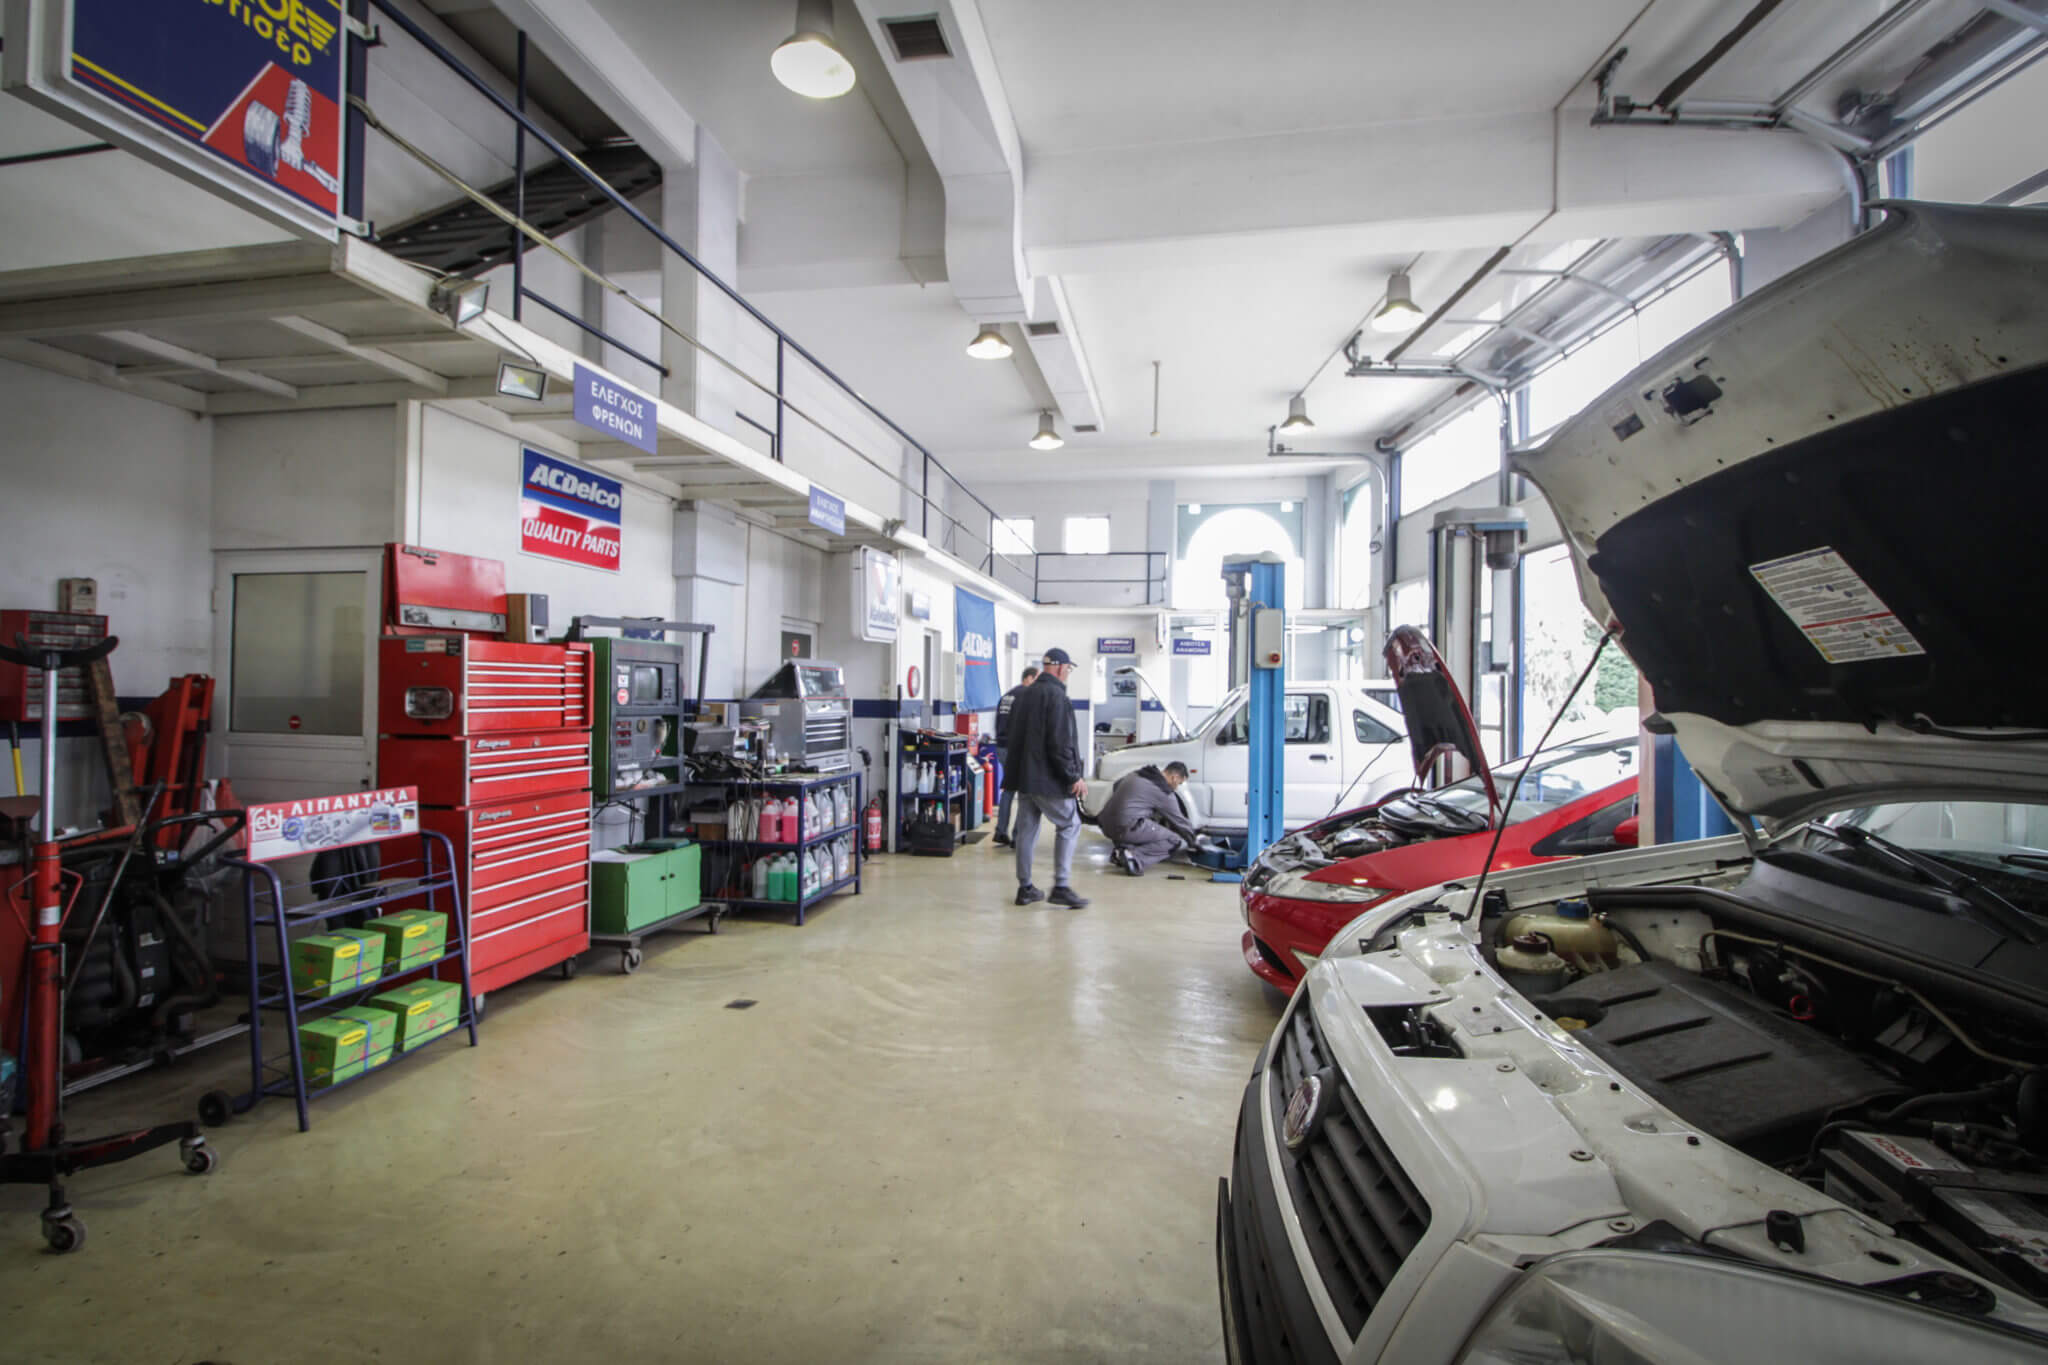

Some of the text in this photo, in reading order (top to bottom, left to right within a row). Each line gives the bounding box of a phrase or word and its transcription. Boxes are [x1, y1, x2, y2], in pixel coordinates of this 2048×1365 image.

[591, 381, 644, 419] ΕΛΕΓΧΟΣ
[592, 404, 643, 440] ΦΡΕΝΩΝ
[529, 463, 620, 509] ACDelco
[523, 518, 620, 558] QUALITY PARTS
[291, 789, 409, 816] ΛΙΠΑΝΤΙΚΑ
